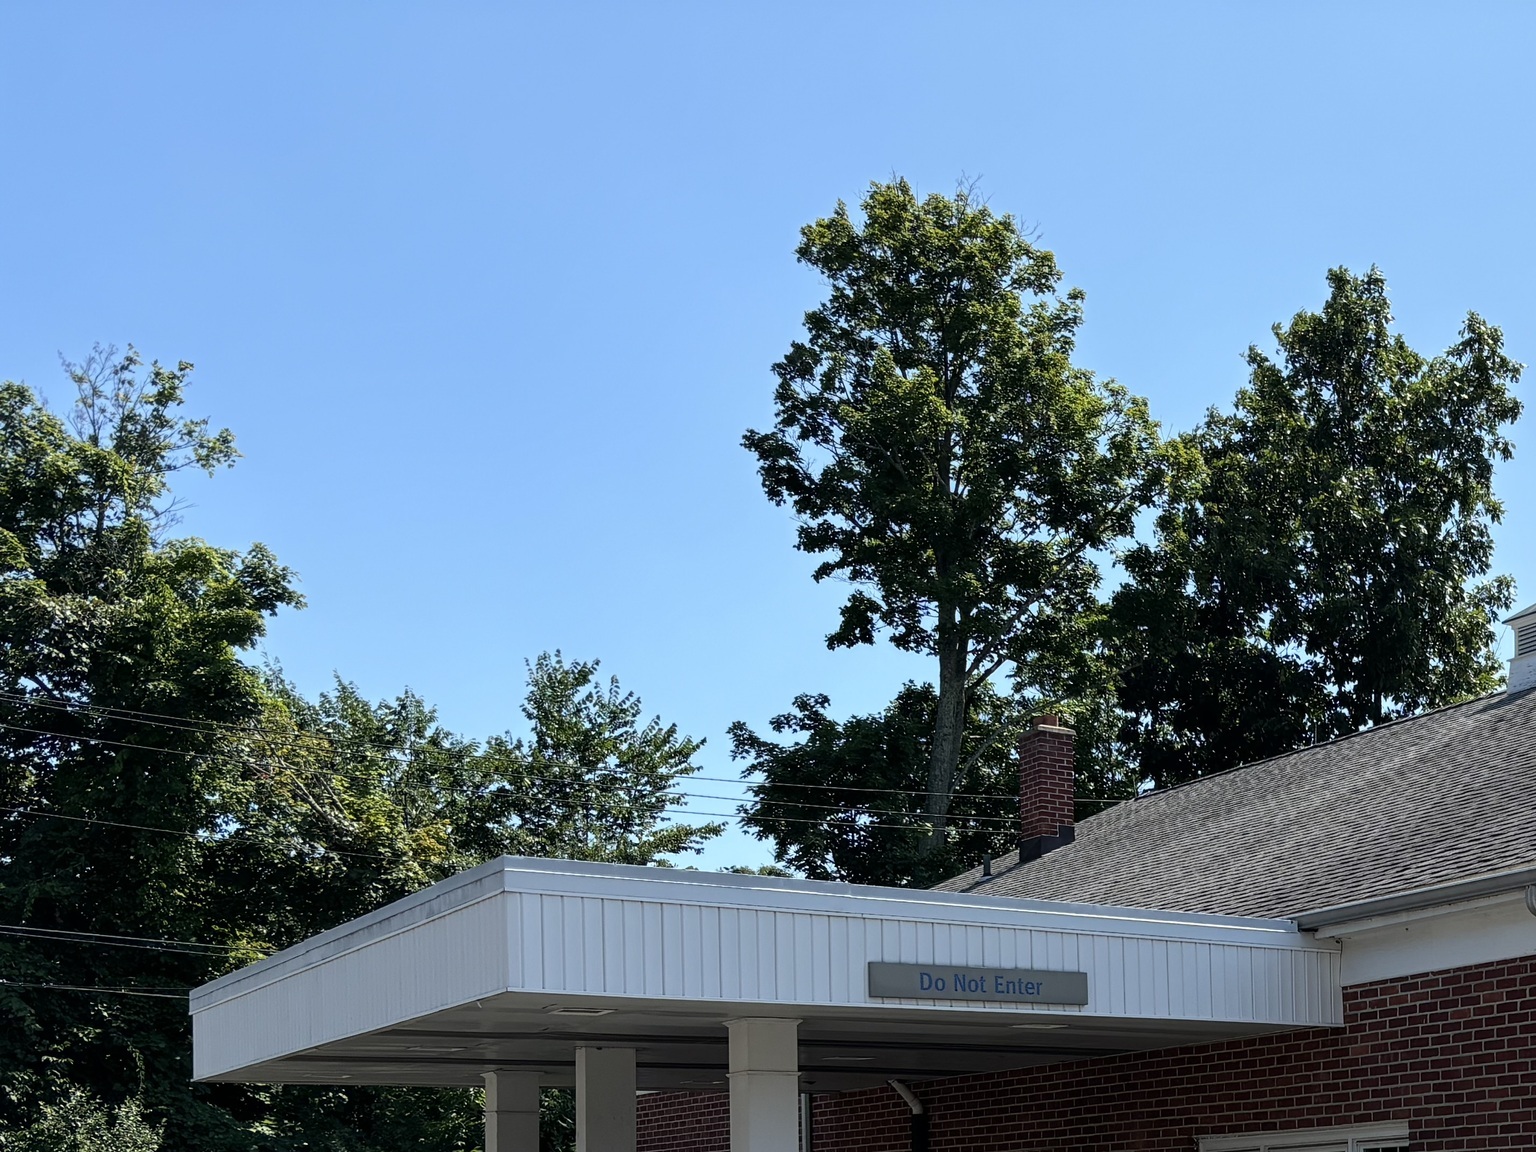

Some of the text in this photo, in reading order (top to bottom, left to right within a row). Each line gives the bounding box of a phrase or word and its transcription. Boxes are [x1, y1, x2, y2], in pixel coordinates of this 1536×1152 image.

[919, 972, 1043, 996] Do Not Enter
